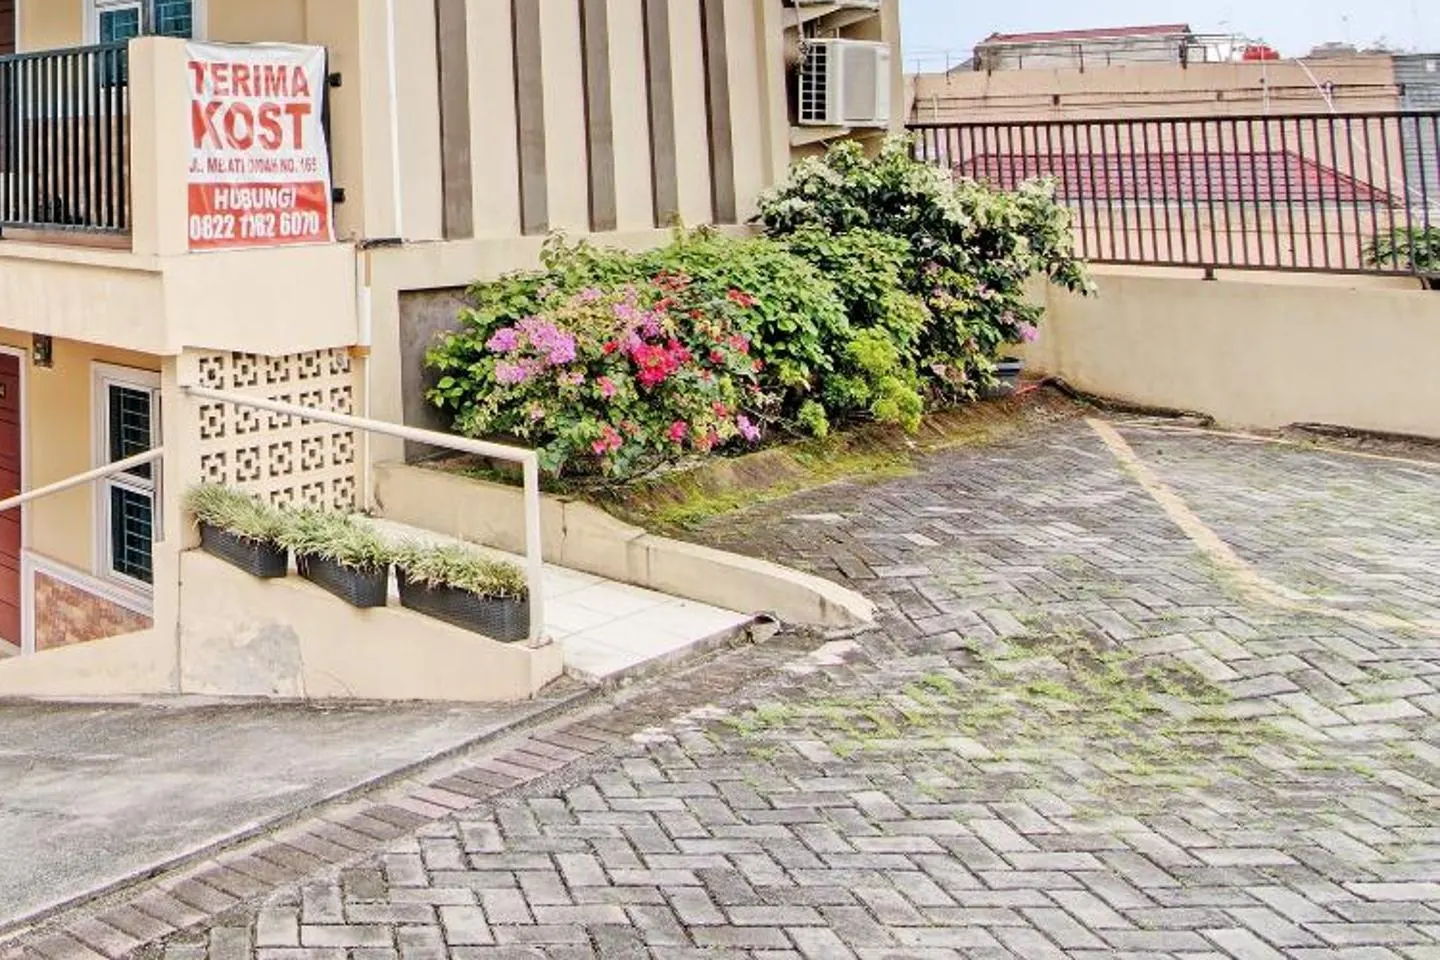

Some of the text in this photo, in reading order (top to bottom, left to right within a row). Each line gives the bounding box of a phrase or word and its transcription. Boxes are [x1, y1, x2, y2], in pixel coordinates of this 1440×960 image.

[188, 60, 310, 97] TERIMA
[191, 99, 312, 151] KOST
[214, 187, 297, 210] HUBUNGI
[190, 214, 236, 240] 0822
[279, 210, 320, 237] 6070
